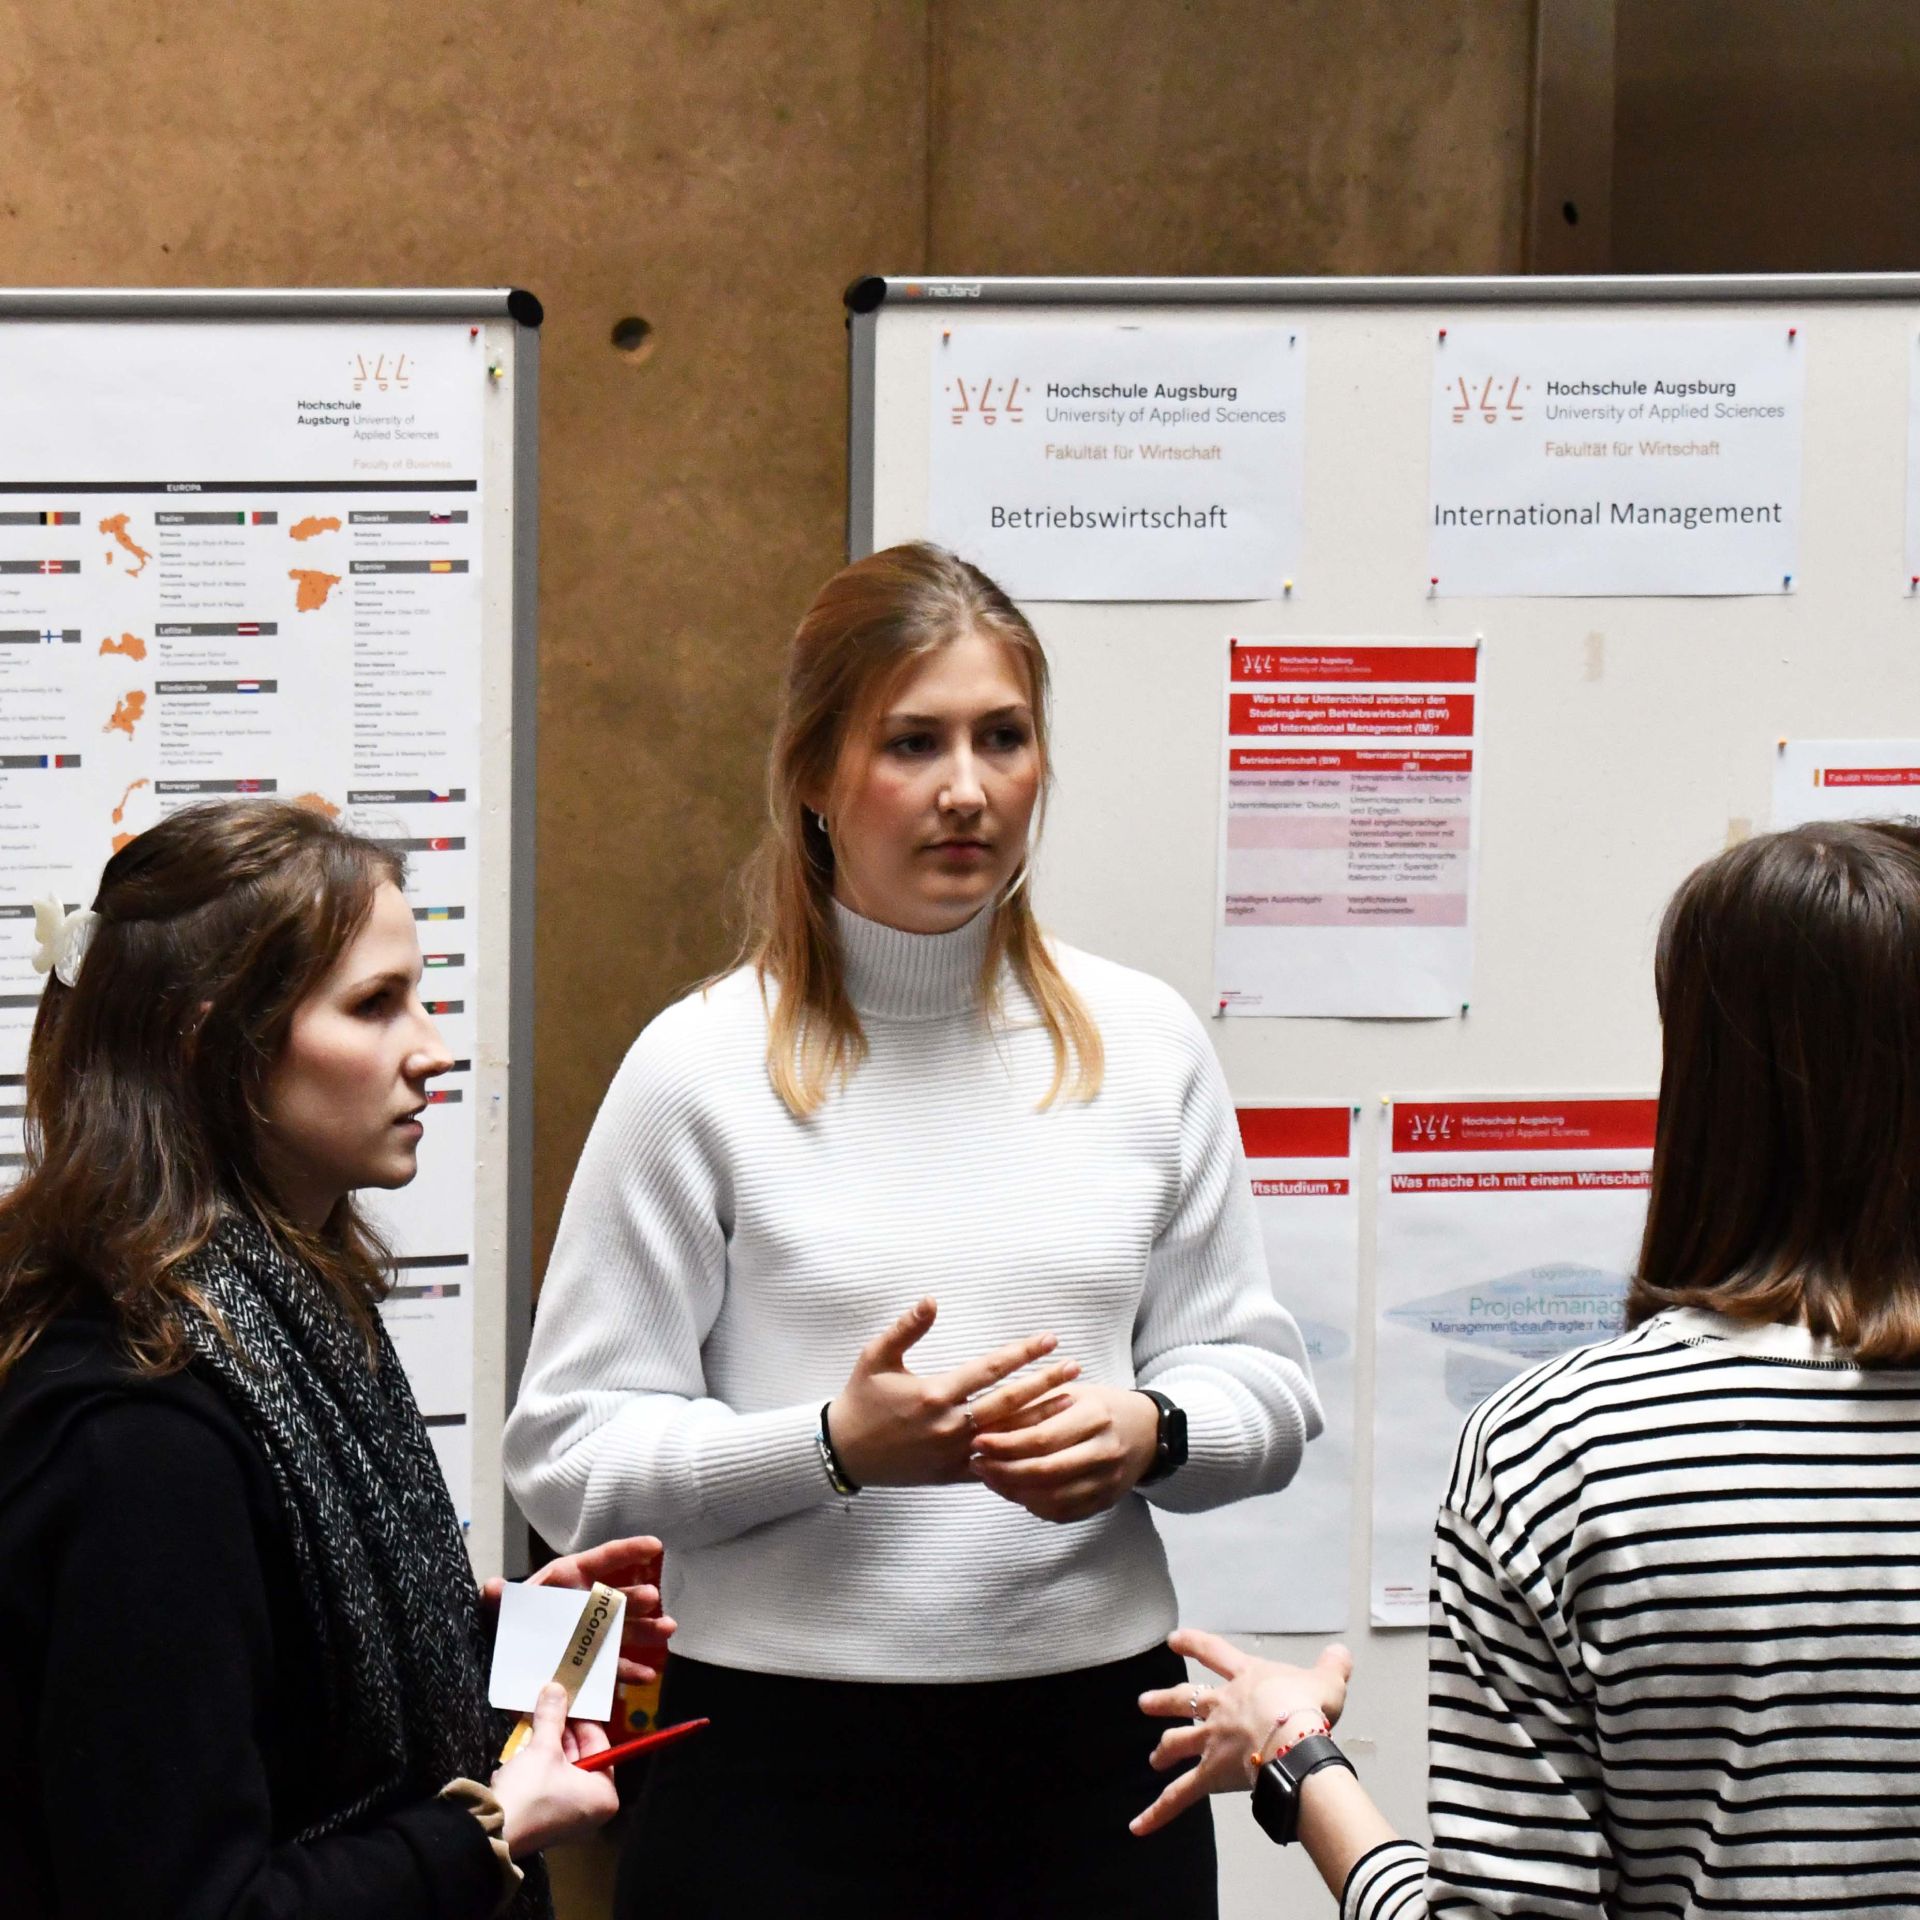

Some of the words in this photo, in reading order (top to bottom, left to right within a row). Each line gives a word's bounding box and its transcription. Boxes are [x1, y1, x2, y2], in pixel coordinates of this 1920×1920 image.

[928, 284, 981, 297] neuland
[1047, 383, 1148, 398] Hochschule
[1154, 383, 1238, 401] Augsburg
[1547, 381, 1647, 396] Hochschule
[1653, 380, 1736, 397] Augsburg
[297, 400, 362, 410] Hochschule
[1046, 406, 1125, 425] University
[1129, 406, 1144, 422] of
[1149, 406, 1210, 425] Applied
[1215, 406, 1286, 422] Sciences
[1546, 404, 1624, 423] University
[1628, 404, 1644, 419] of
[1648, 404, 1709, 423] Applied
[1714, 404, 1785, 419] Sciences
[297, 415, 350, 426] Augsburg
[353, 415, 402, 426] University
[405, 415, 415, 424] of
[353, 430, 391, 440] Applied
[394, 430, 440, 440] Sciences
[1044, 444, 1107, 460] Fakultät
[1113, 444, 1134, 460] für
[1139, 444, 1222, 460] Wirtschaft
[1545, 441, 1607, 457] Fakultät
[1613, 441, 1633, 456] für
[1638, 440, 1720, 456] Wirtschaft
[166, 484, 202, 492] EUROPA
[990, 505, 1228, 529] Betriebswirtschaft
[1434, 501, 1601, 527] International
[1610, 502, 1782, 530] Management
[1253, 694, 1275, 704] Was
[1277, 694, 1290, 704] ist
[1293, 694, 1310, 704] der
[1312, 694, 1374, 704] Unterschied
[1376, 695, 1424, 704] zwischen
[1426, 695, 1446, 704] den
[1249, 709, 1326, 720] Studiengängen
[1328, 708, 1421, 719] Betriebswirtschaft
[1423, 708, 1450, 720] (BW)
[1258, 723, 1278, 733] und
[1280, 723, 1345, 733] International
[1347, 723, 1413, 734] Management
[1239, 756, 1317, 765] Betriebswirtschaft
[1462, 1116, 1516, 1126] Hochschule
[1519, 1116, 1564, 1127] Augsburg
[1393, 1175, 1423, 1189] Was
[1427, 1174, 1474, 1188] mache
[1478, 1174, 1500, 1187] ich
[1504, 1174, 1526, 1187] mit
[1530, 1174, 1573, 1187] einem
[1334, 1182, 1342, 1194] ?
